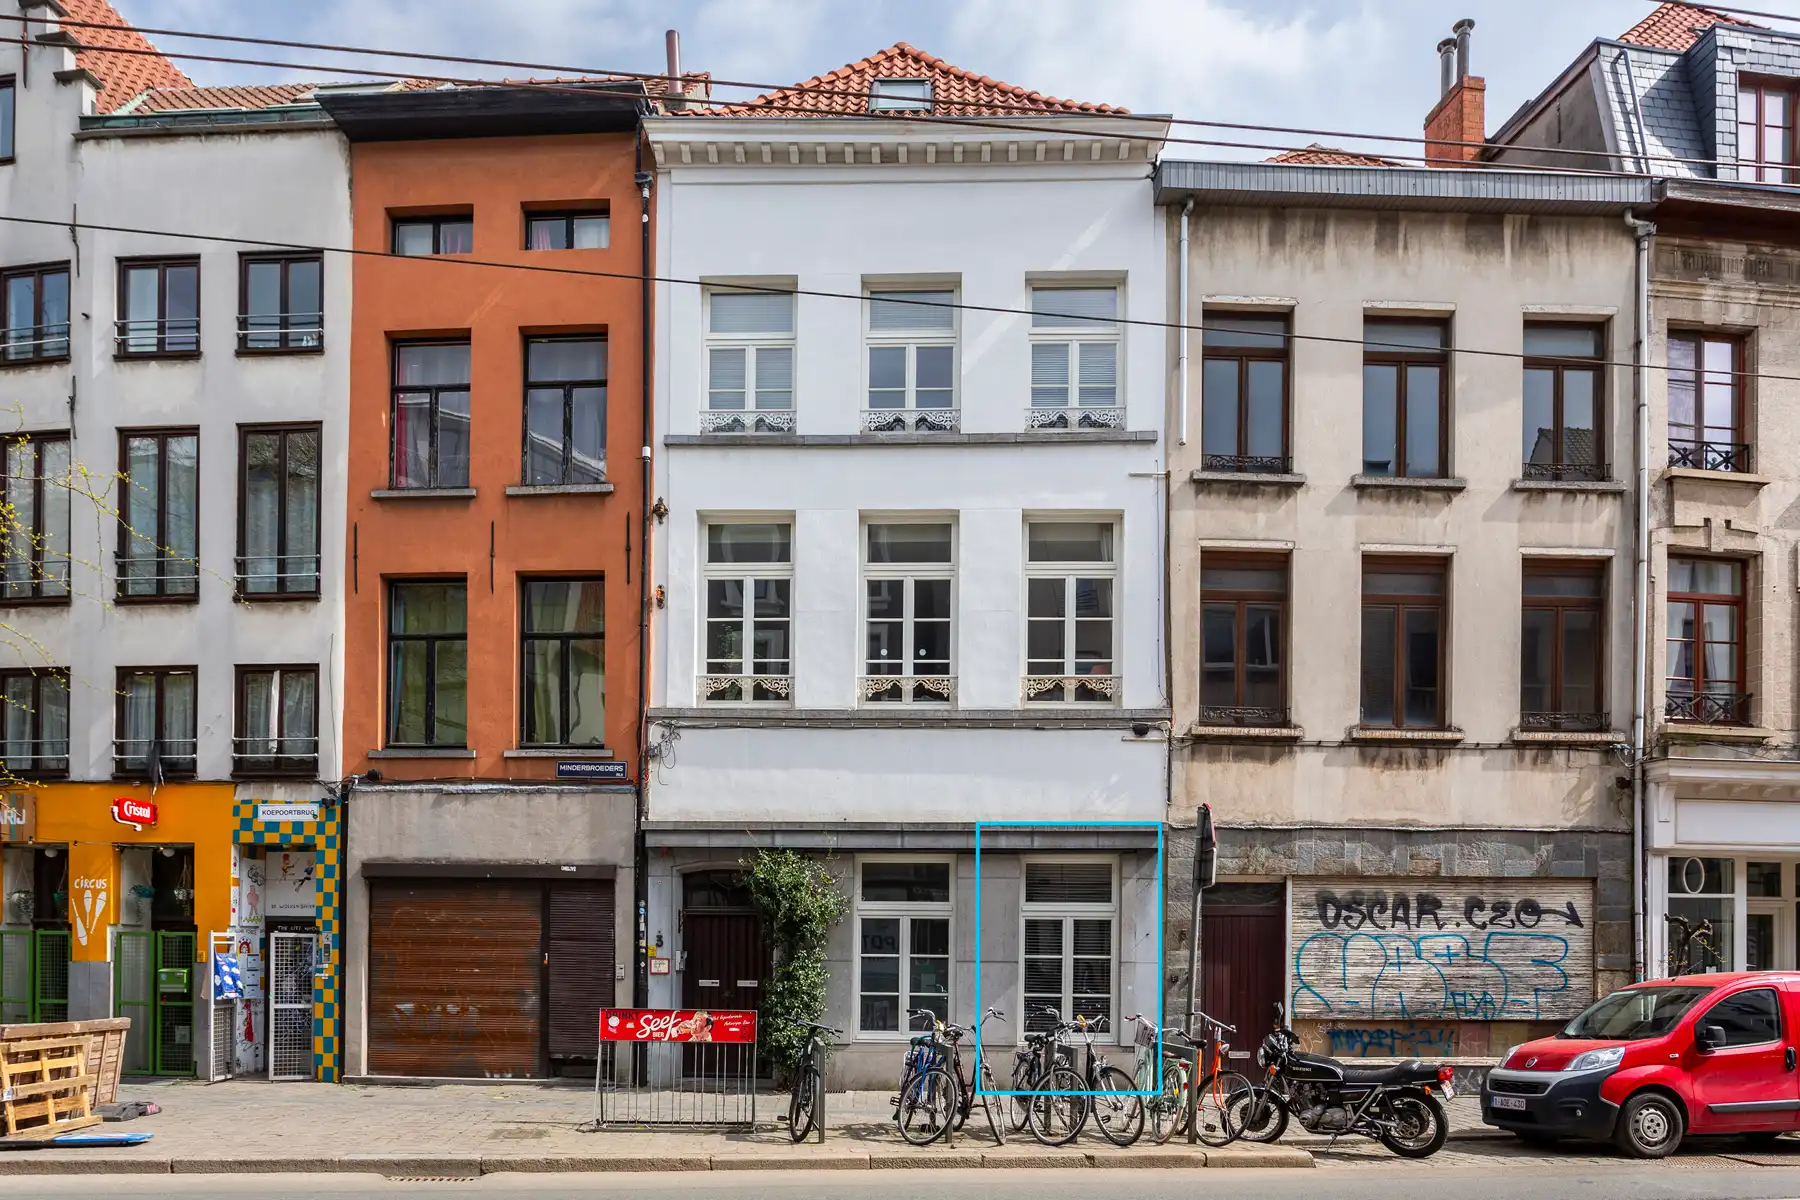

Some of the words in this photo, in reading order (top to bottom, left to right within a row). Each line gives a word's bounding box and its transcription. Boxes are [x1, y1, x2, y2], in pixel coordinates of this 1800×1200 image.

[559, 764, 624, 772] MINDERBROEDERS
[123, 800, 151, 819] Cristal
[655, 934, 664, 948] 3
[636, 1010, 682, 1041] Seef
